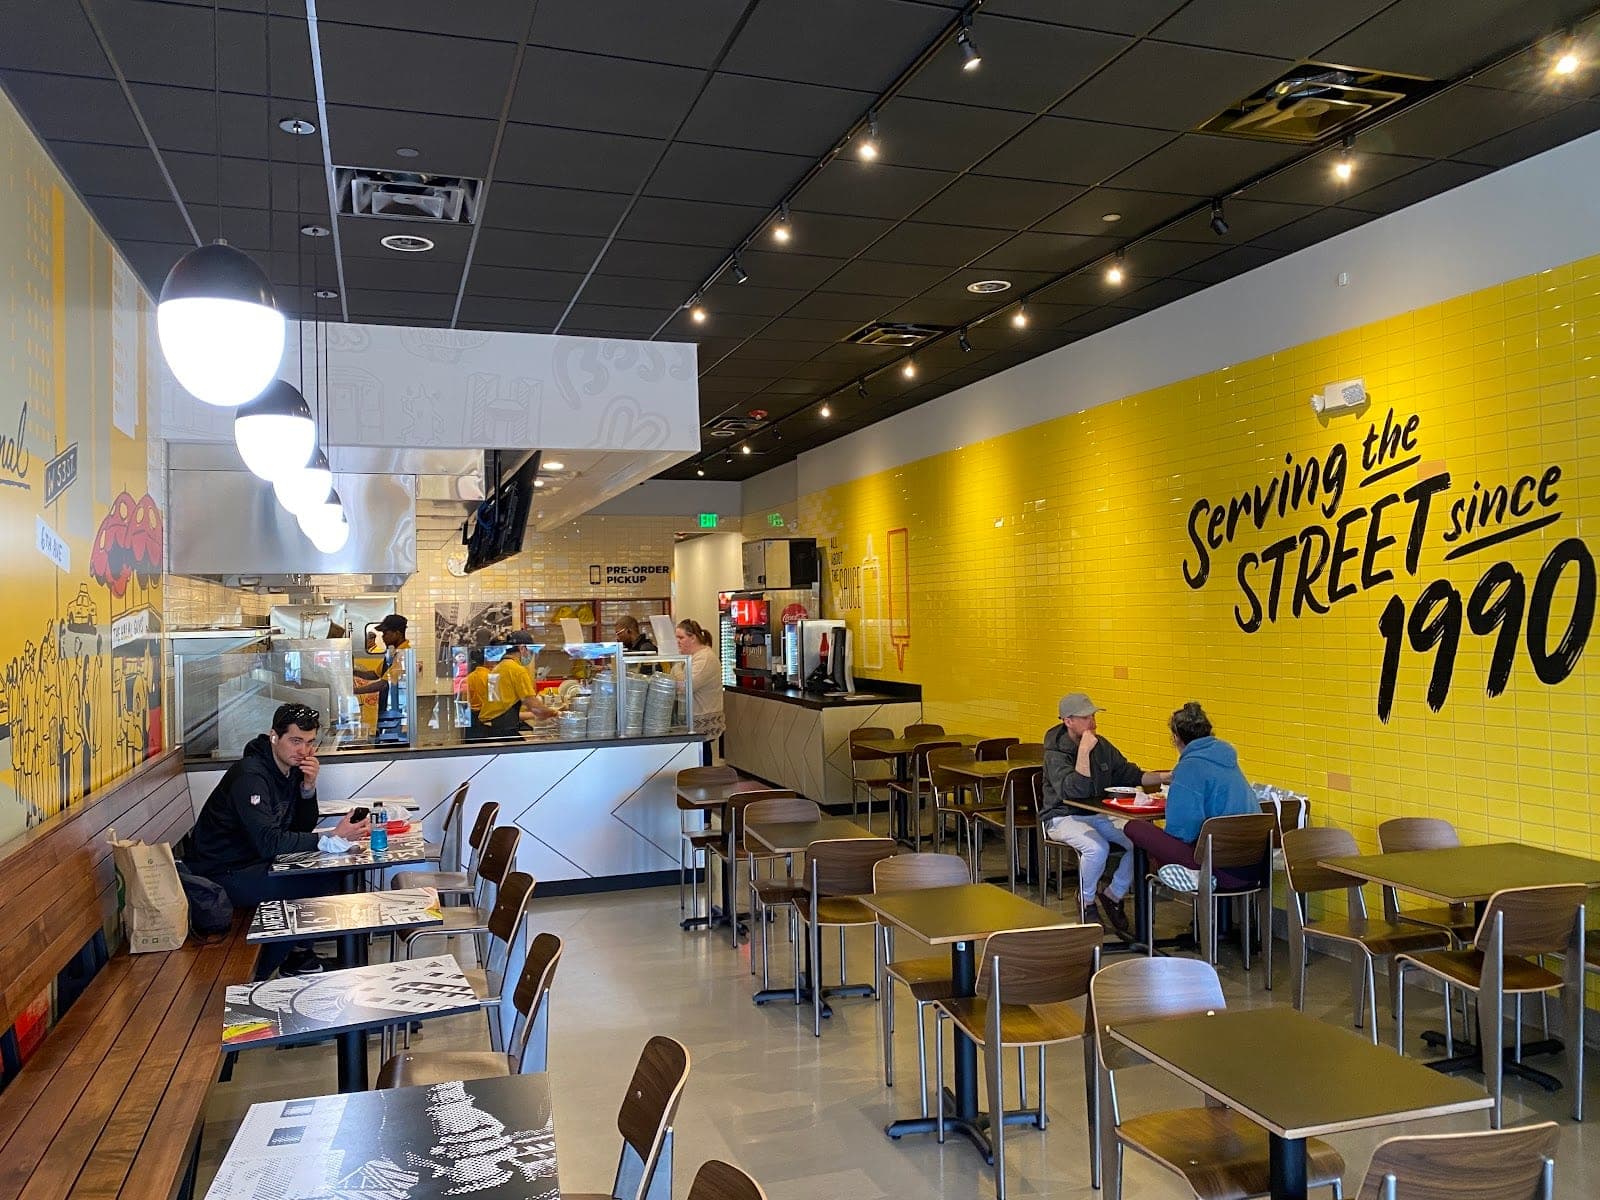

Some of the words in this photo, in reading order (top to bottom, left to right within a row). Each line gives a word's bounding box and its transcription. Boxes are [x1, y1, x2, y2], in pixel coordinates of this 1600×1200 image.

[606, 565, 670, 574] PRE-ORDER
[606, 575, 647, 584] PICKUP
[1182, 443, 1347, 590] Serving
[1361, 407, 1421, 472] the
[1234, 471, 1452, 634] STREET
[1442, 464, 1563, 543] since
[1376, 537, 1598, 726] 1990
